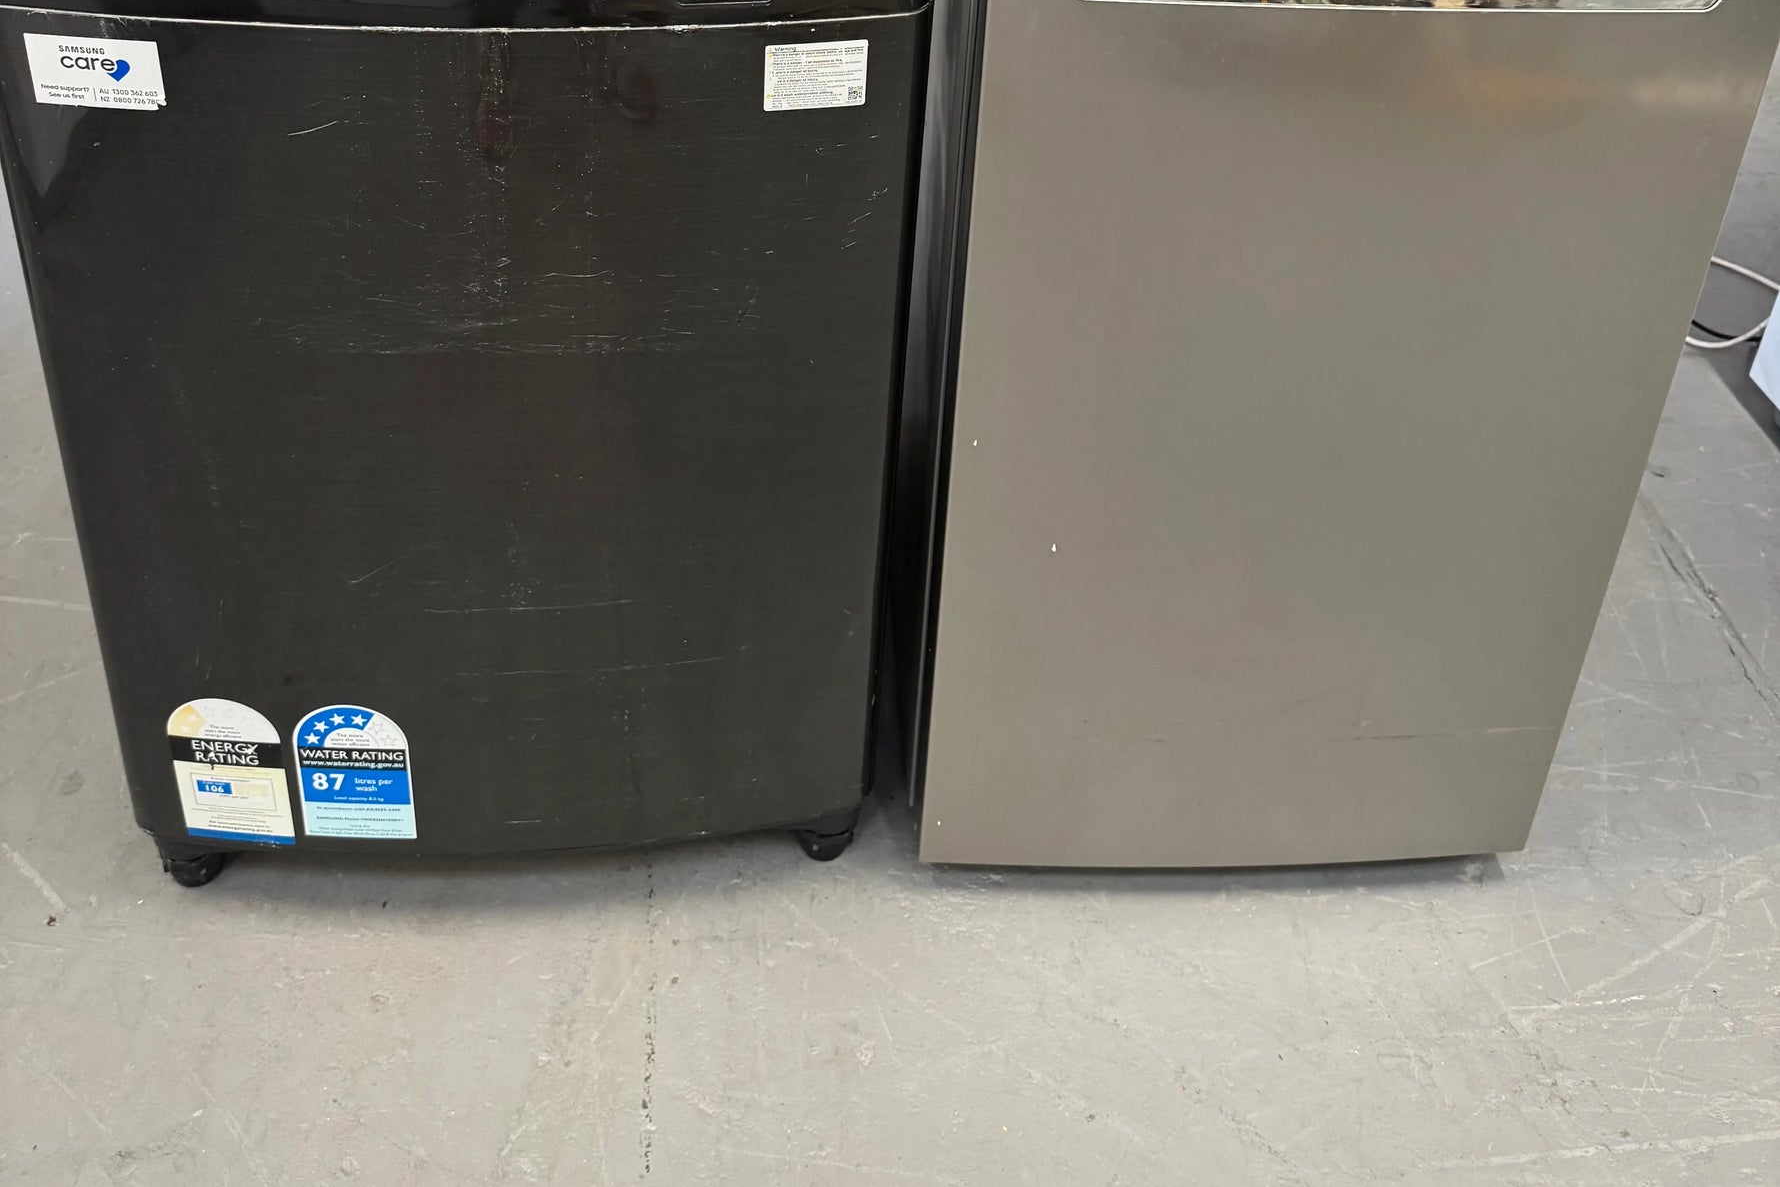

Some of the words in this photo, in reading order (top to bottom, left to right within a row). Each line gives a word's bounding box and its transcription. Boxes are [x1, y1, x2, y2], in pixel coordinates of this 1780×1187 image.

[58, 44, 105, 55] SAMSUNG
[60, 55, 116, 72] care
[60, 85, 90, 93] support?
[190, 739, 260, 755] ENERGY
[194, 750, 260, 766] RATING
[299, 748, 349, 760] WATER
[352, 750, 404, 762] RATING
[303, 759, 404, 769] www.waterrating.gov.au
[205, 784, 225, 793] 106
[311, 772, 346, 791] 87
[354, 777, 377, 785] litres
[378, 778, 394, 787] per
